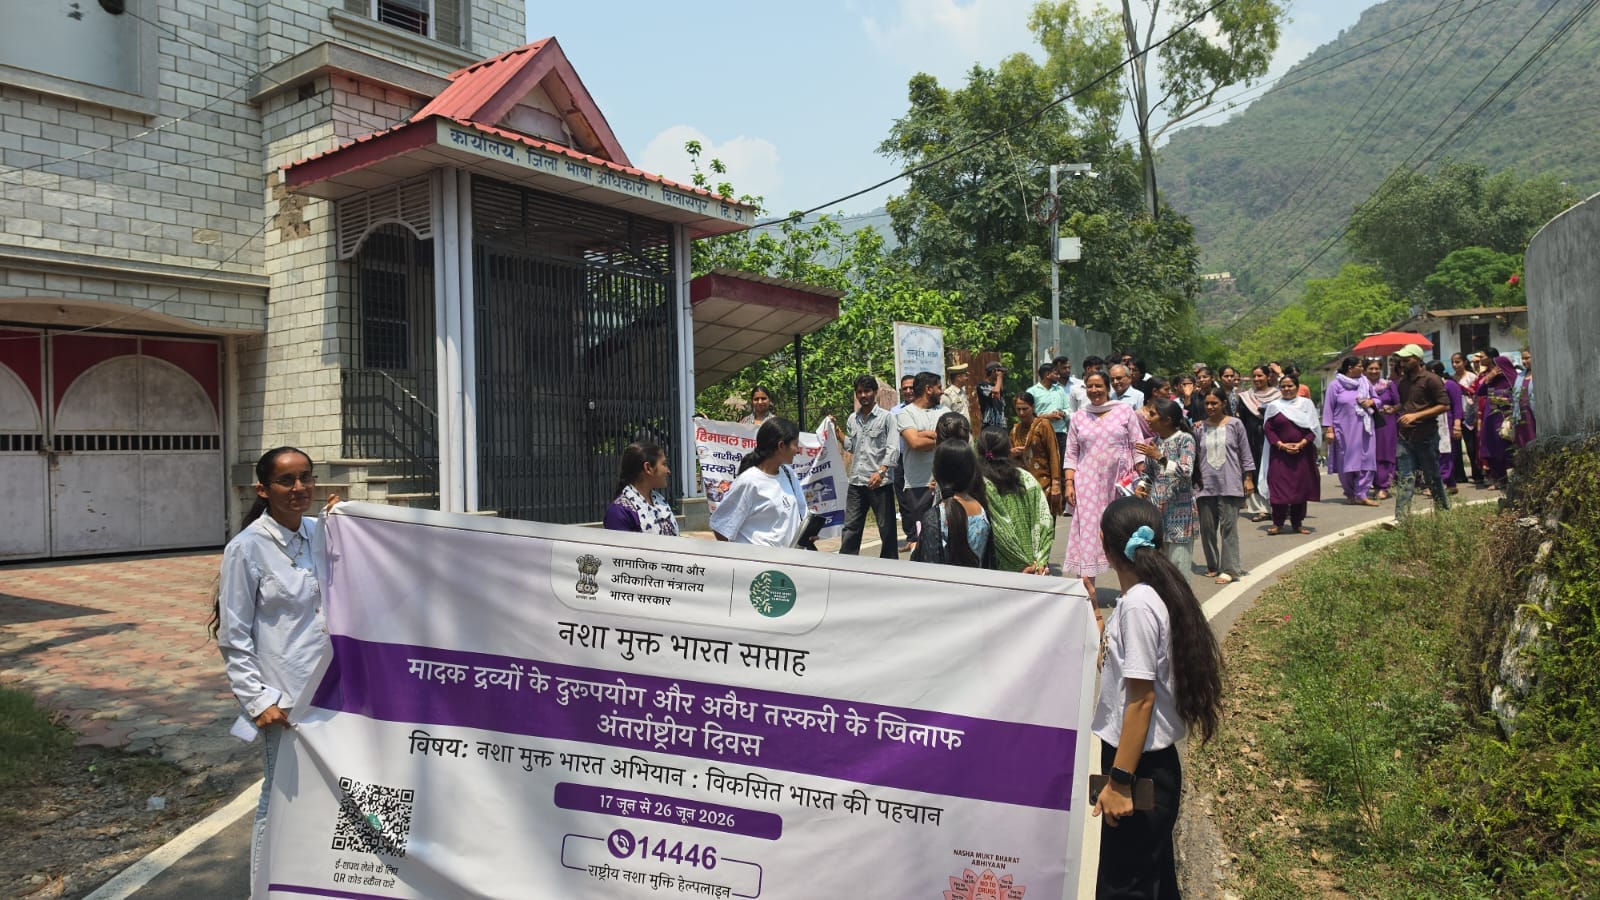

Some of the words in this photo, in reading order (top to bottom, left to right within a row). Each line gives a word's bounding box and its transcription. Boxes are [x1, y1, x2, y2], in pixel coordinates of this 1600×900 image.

[526, 147, 559, 171] जिला
[564, 159, 593, 181] भाषा
[661, 185, 709, 214] बिलासपुर
[696, 427, 739, 446] हिमाचल
[612, 557, 658, 571] सामाजिक
[661, 563, 684, 574] न्याय
[686, 562, 706, 576] और
[610, 572, 664, 589] अधिकारिता
[667, 577, 705, 592] मंत्रालय
[610, 590, 634, 602] भारत
[637, 593, 672, 606] सरकार
[558, 621, 610, 650] नशा
[615, 628, 663, 661] मुक्त
[670, 634, 732, 665] भारत
[738, 643, 810, 676] सप्ताह
[407, 658, 470, 684] मादक
[473, 663, 525, 691] द्रव्यों
[528, 667, 552, 694] के
[652, 683, 696, 715] और
[700, 690, 758, 723] अवैध
[763, 704, 840, 734] तस्करी
[844, 707, 870, 737] के
[875, 711, 965, 751] खिलाफ
[597, 709, 697, 750] अंतर्राष्ट्रीय
[701, 721, 764, 757] दिवस
[408, 729, 469, 760] विषय:
[476, 740, 515, 763] नशा
[518, 747, 554, 772] मुक्त
[559, 752, 606, 775] भारत
[610, 755, 686, 787] अभियान
[705, 766, 784, 802] विकसित
[789, 785, 838, 811] भारत
[842, 789, 870, 816] की
[875, 798, 944, 827] पहचान
[600, 794, 613, 809] 17
[616, 797, 636, 815] जून
[639, 797, 652, 814] से
[654, 802, 672, 817] 26
[675, 805, 696, 824] जून
[698, 809, 735, 828] 2026
[638, 836, 717, 870] 14446
[953, 849, 974, 858] NASHA
[975, 852, 994, 860] MUKT
[995, 855, 1020, 864] BHARAT
[971, 859, 1006, 870] ABHIYAAN
[333, 872, 346, 883] QR
[347, 873, 362, 885] कोड
[361, 861, 374, 872] लेने
[376, 863, 384, 873] के
[587, 863, 619, 881] राष्ट्रीय
[623, 870, 646, 885] नशा
[649, 872, 675, 891] मुक्ति
[677, 878, 732, 900] हेल्पलाइन
